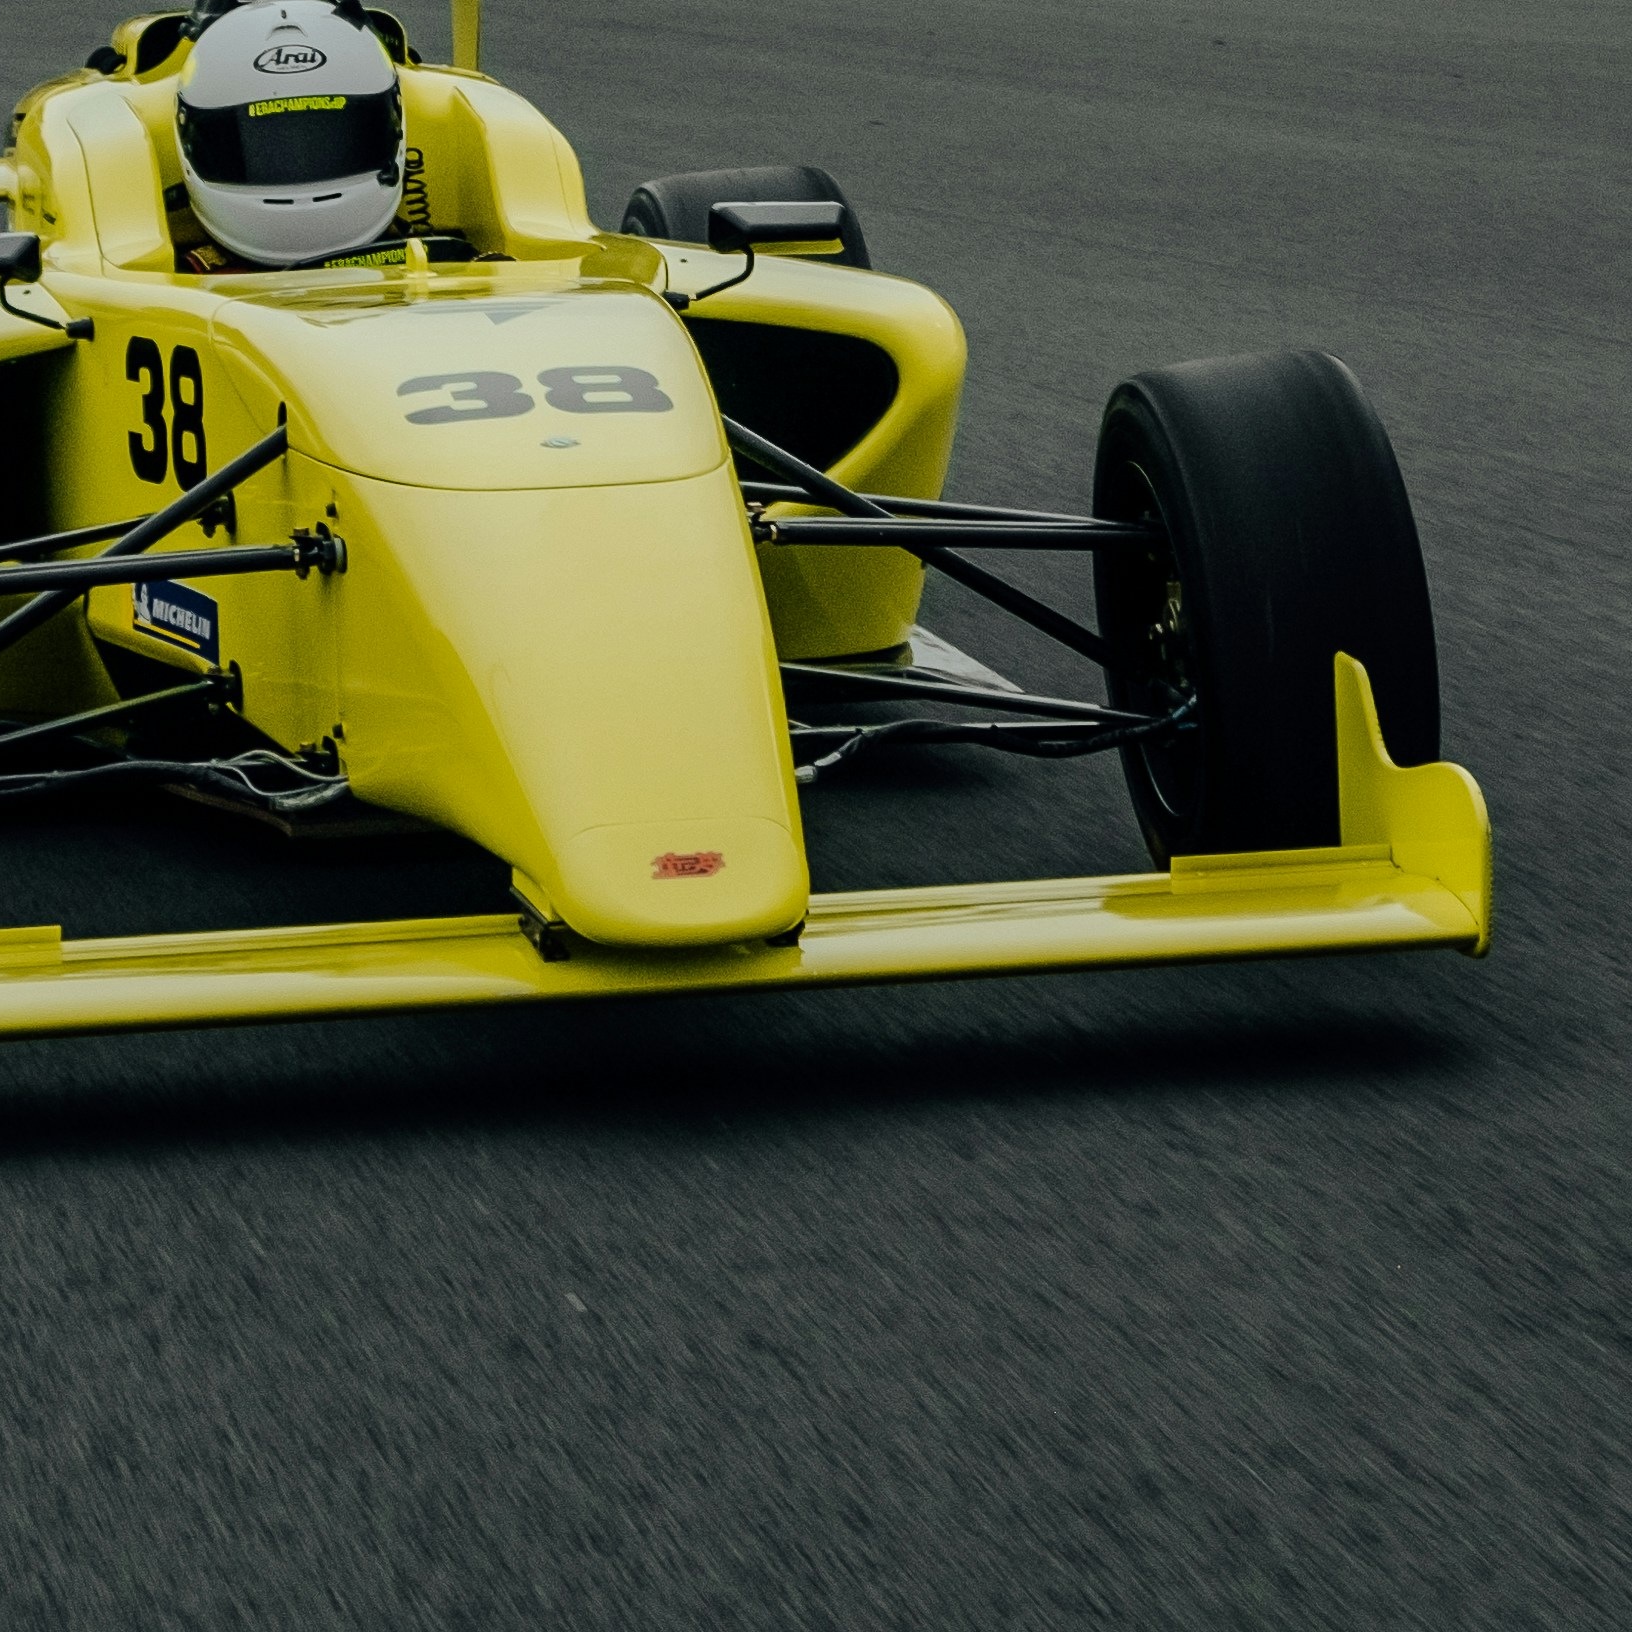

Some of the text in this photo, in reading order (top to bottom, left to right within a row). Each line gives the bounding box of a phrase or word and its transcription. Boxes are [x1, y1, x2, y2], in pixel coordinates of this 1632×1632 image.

[259, 48, 317, 69] Arai
[125, 335, 207, 493] 38
[396, 366, 674, 426] 38
[152, 598, 211, 640] MICHELIN
